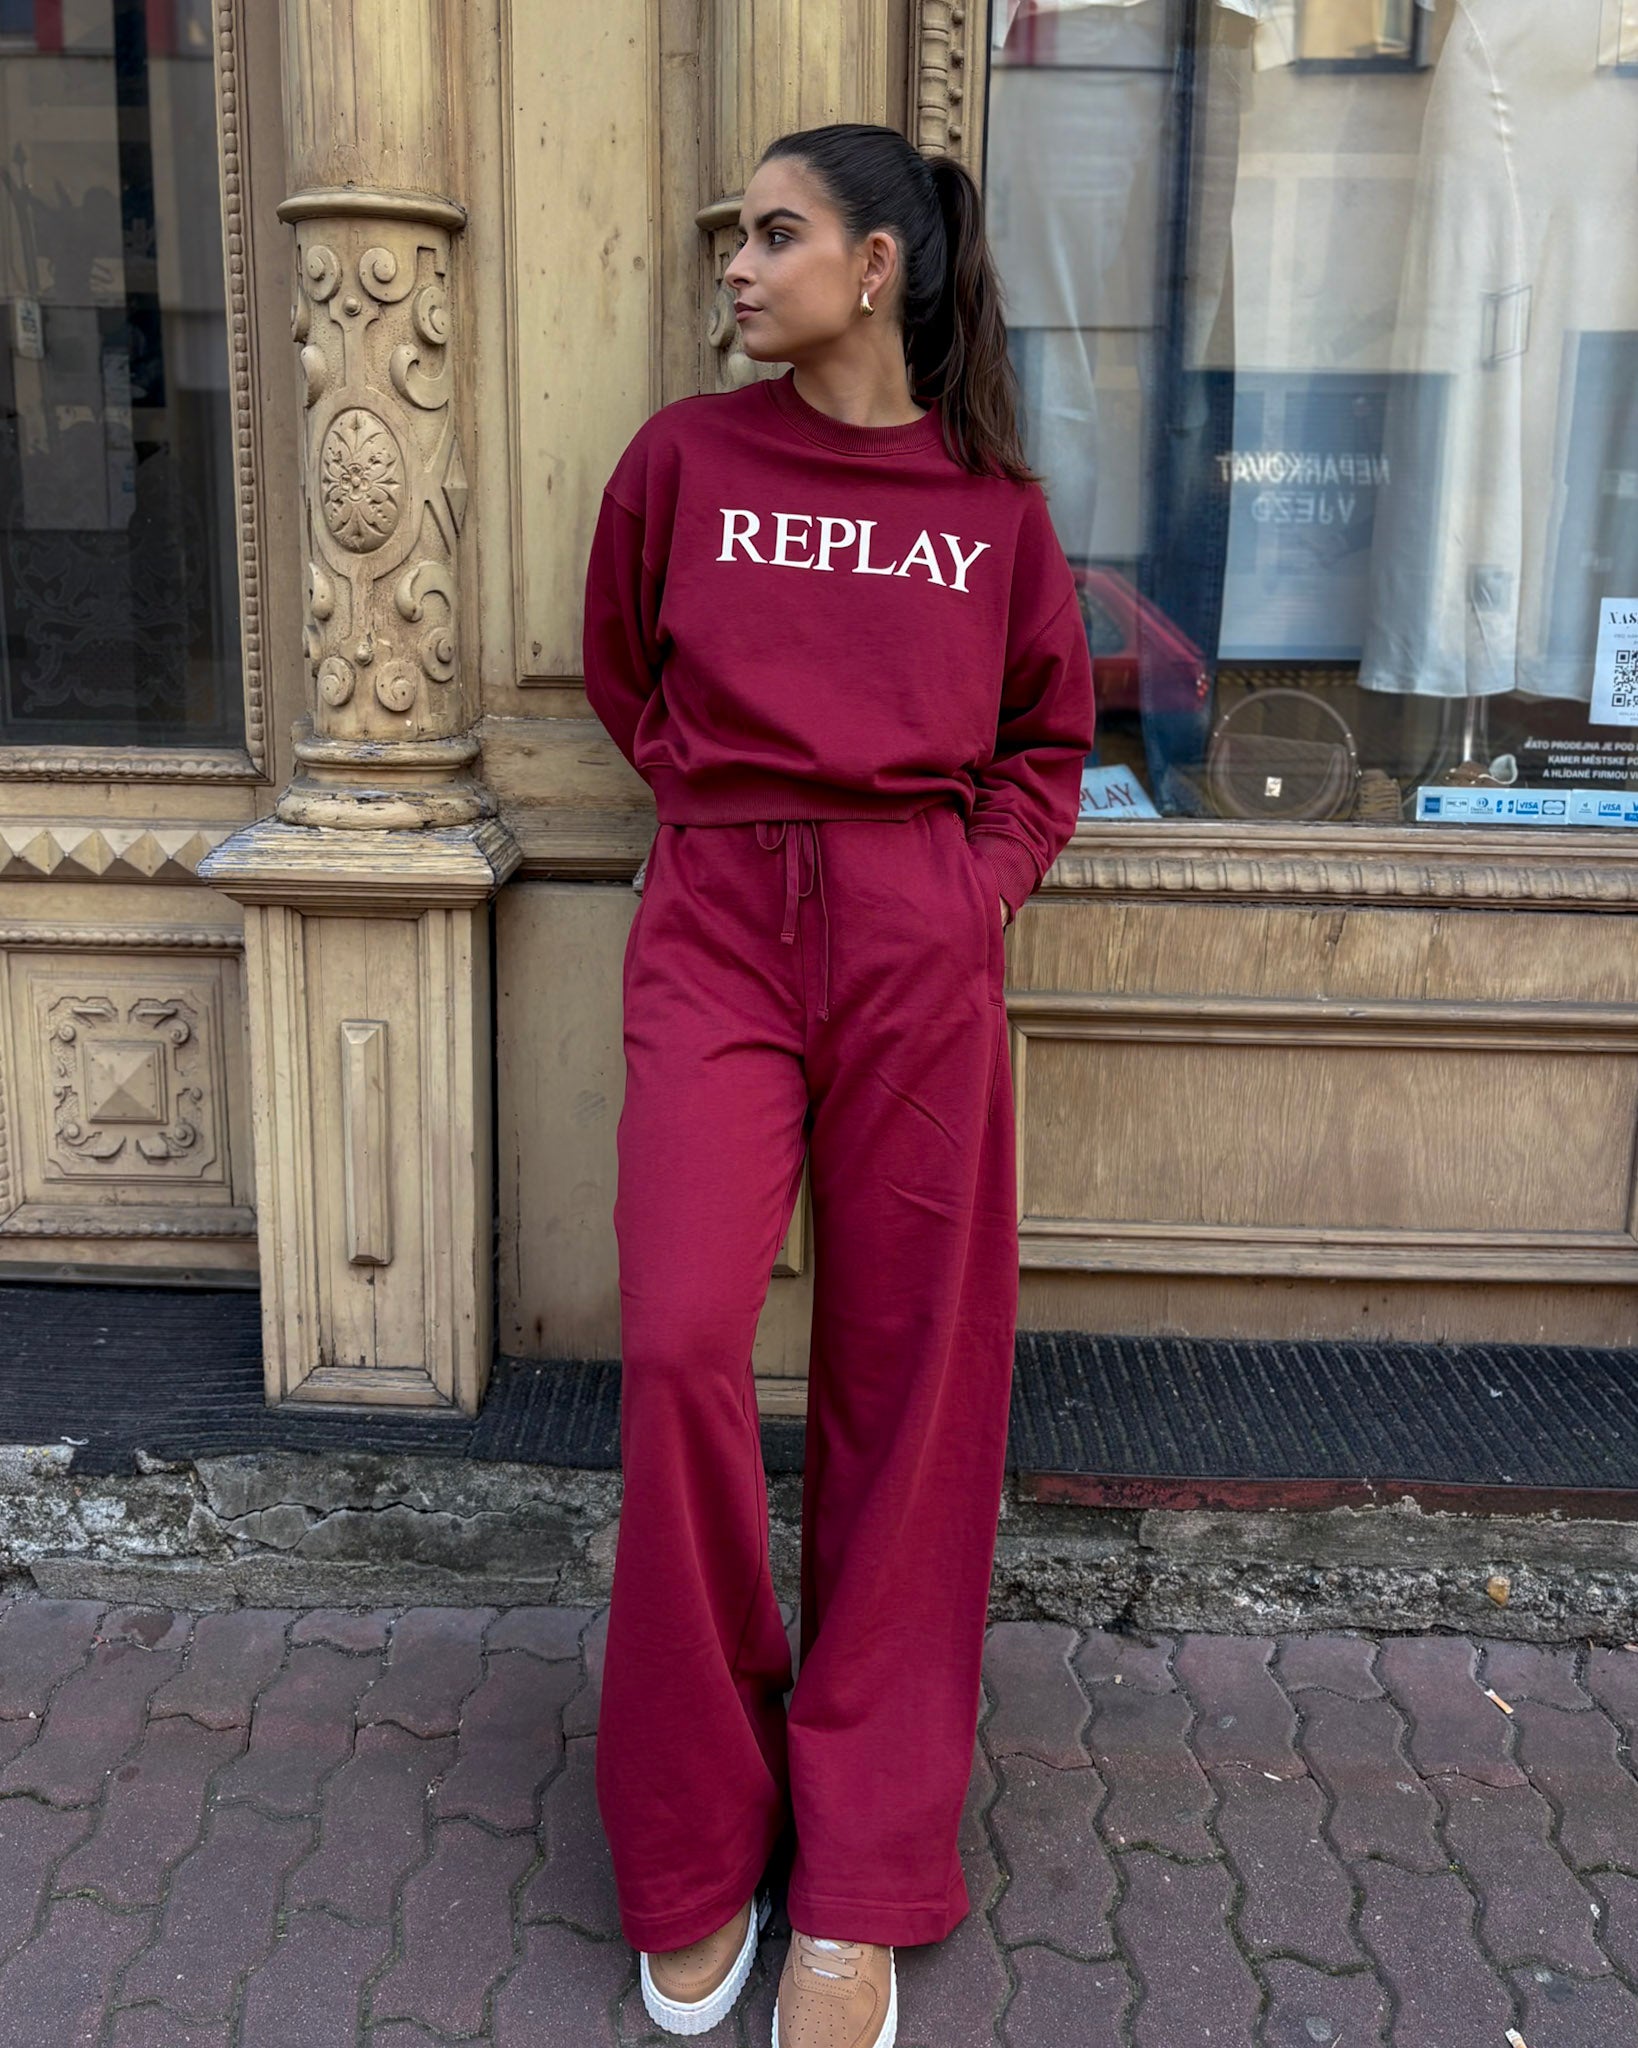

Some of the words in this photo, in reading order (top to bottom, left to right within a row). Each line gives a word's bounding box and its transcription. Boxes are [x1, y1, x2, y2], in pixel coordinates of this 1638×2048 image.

[715, 508, 991, 593] REPLAY
[1547, 755, 1580, 766] KAMER
[1542, 769, 1550, 779] A
[1550, 768, 1591, 779] HLÍDANÉ
[1591, 770, 1629, 780] FIRMOU
[1519, 801, 1539, 809] VISA
[1602, 803, 1622, 811] VISA
